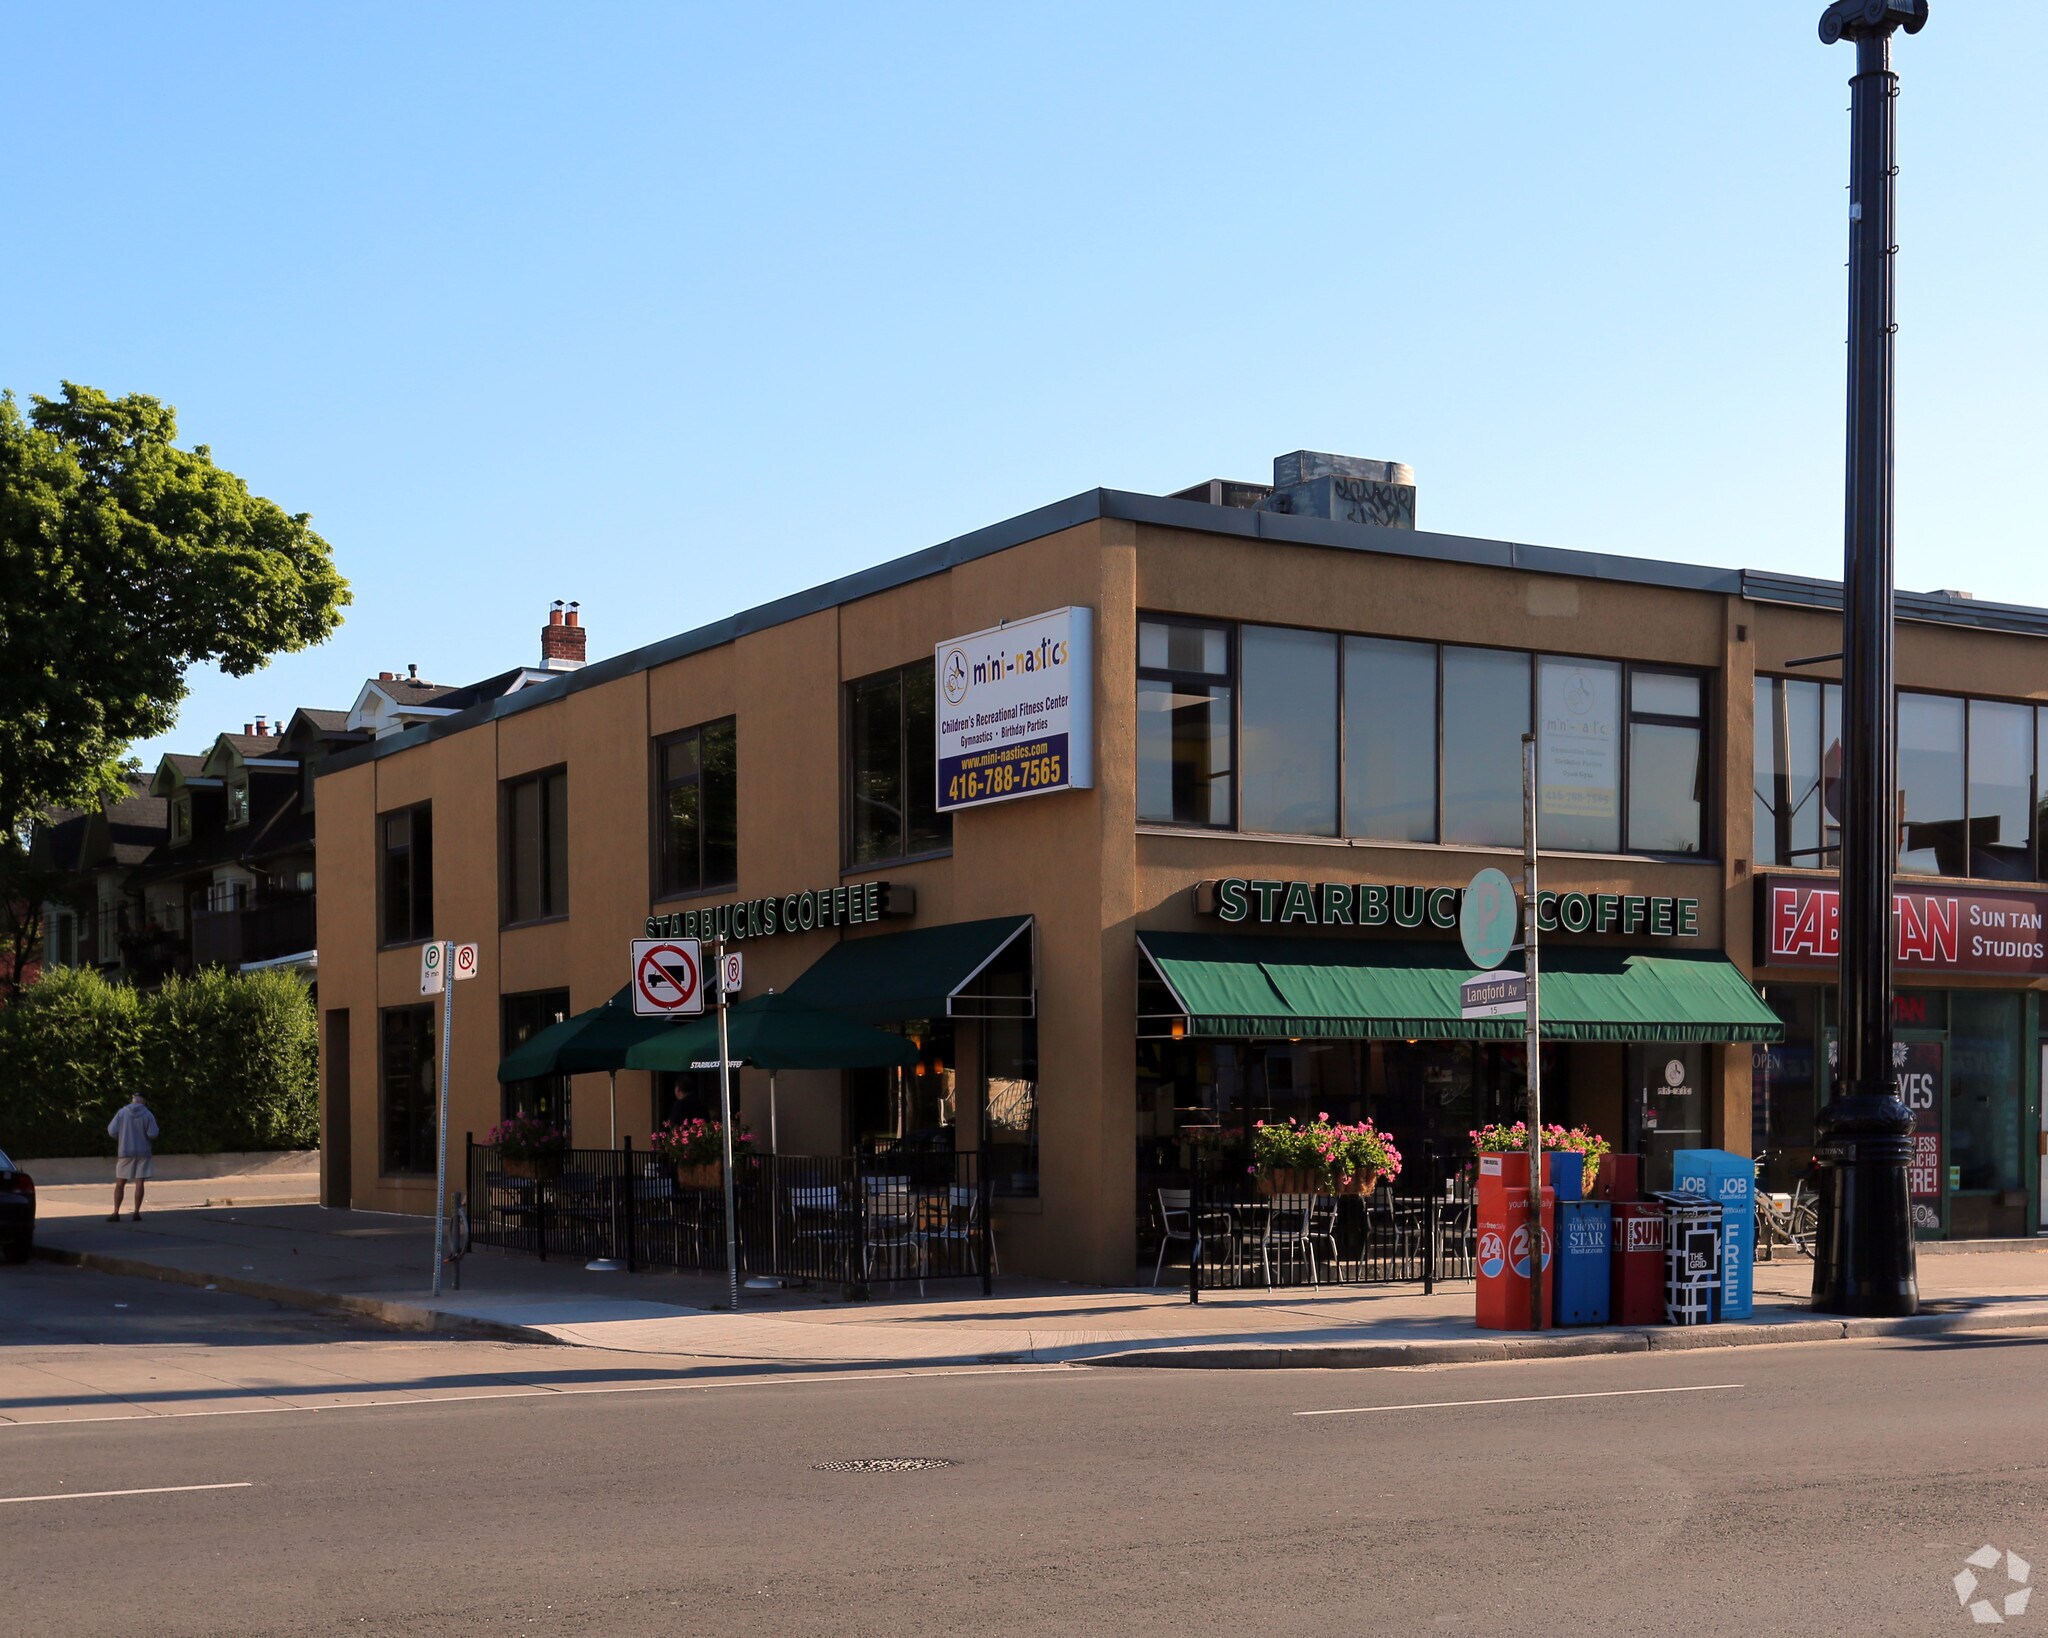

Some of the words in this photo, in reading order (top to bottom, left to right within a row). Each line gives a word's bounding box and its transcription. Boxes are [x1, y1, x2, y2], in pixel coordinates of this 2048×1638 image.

[973, 637, 1068, 686] mini-nastics
[942, 714, 975, 734] Children's
[976, 704, 1018, 728] Recreational
[1019, 701, 1044, 717] Fitness
[1045, 694, 1068, 711] Center
[960, 731, 993, 749] Gymnastics
[1001, 725, 1026, 739] Birthday
[1027, 718, 1048, 733] Parties
[961, 741, 1048, 770] www.mini-nastics.com
[949, 755, 1061, 800] 416-788-7565
[783, 881, 879, 933] COFFEE
[1219, 877, 1466, 929] STARBUC
[1537, 889, 1700, 937] COFFEE
[1772, 887, 1959, 962] FABAN
[1467, 983, 1505, 1004] Langford
[1508, 984, 1518, 997] Av
[1490, 1007, 1498, 1015] 15
[1753, 1053, 1781, 1069] OPEN
[1679, 1177, 1706, 1192] JOB
[1720, 1178, 1747, 1194] JOB
[1568, 1222, 1607, 1232] TORONTO
[1569, 1231, 1604, 1246] STAR
[1633, 1220, 1662, 1245] SUN
[1481, 1236, 1501, 1260] 24
[1690, 1252, 1704, 1260] THE
[1690, 1260, 1708, 1269] GRID
[1724, 1223, 1740, 1305] FREE
